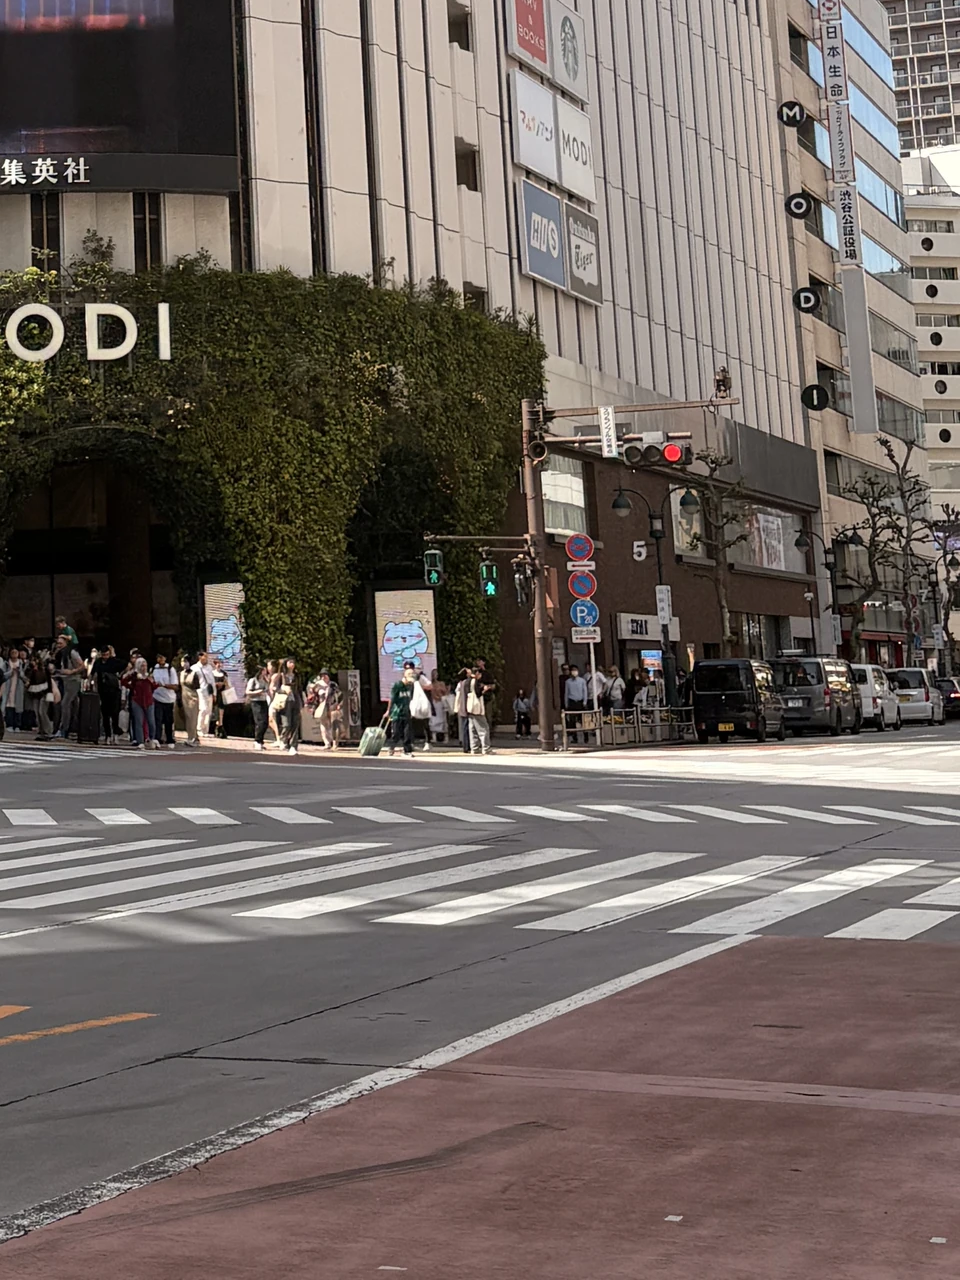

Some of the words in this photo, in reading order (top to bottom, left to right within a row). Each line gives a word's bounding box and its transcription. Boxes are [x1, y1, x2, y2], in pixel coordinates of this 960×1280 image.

[518, 24, 545, 51] BOOKS
[826, 26, 843, 97] 日本生命
[562, 129, 592, 169] MODI
[0, 157, 90, 185] 集英社
[840, 190, 857, 260] 渋谷公証役場
[633, 541, 647, 561] 5
[576, 606, 588, 624] P
